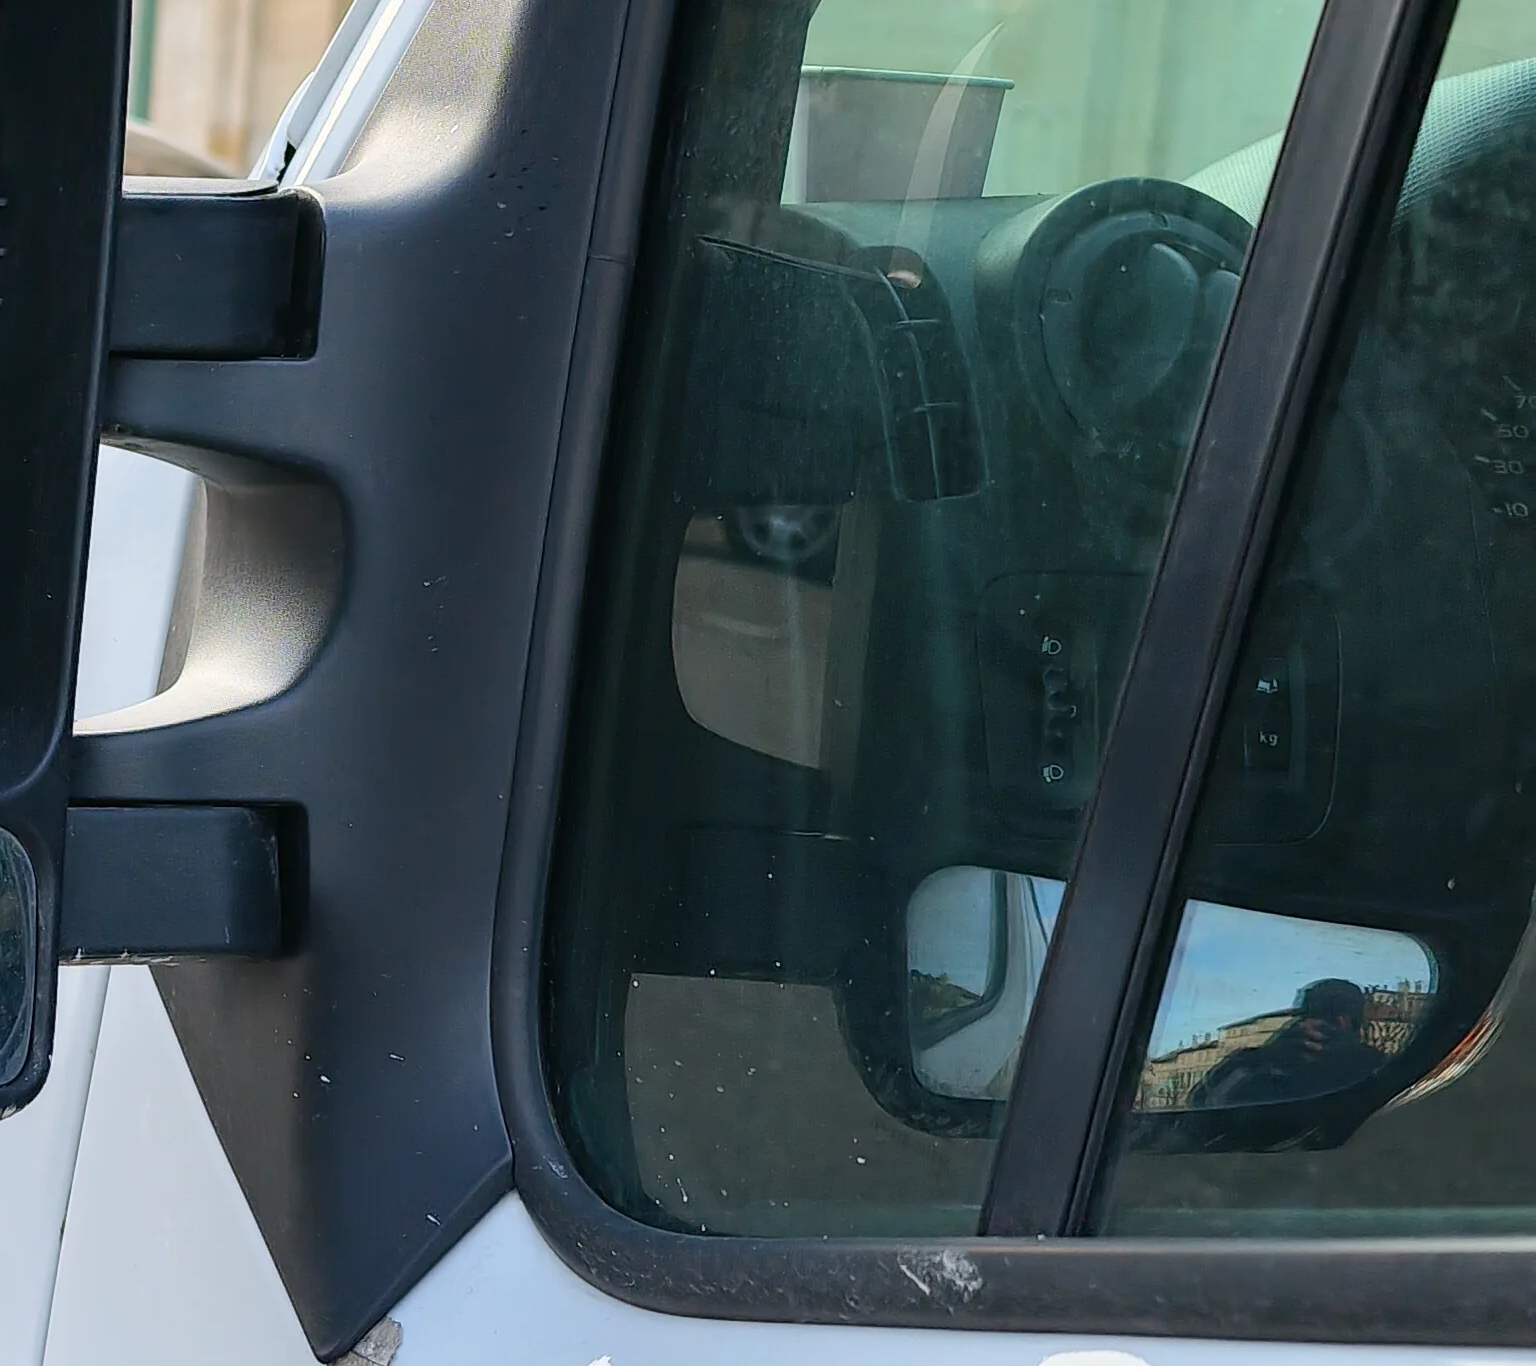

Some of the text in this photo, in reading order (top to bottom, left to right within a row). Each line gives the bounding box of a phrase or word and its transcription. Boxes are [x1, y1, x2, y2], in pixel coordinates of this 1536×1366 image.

[1497, 424, 1529, 439] 50
[1492, 459, 1525, 475] 30
[1259, 731, 1278, 747] kg
